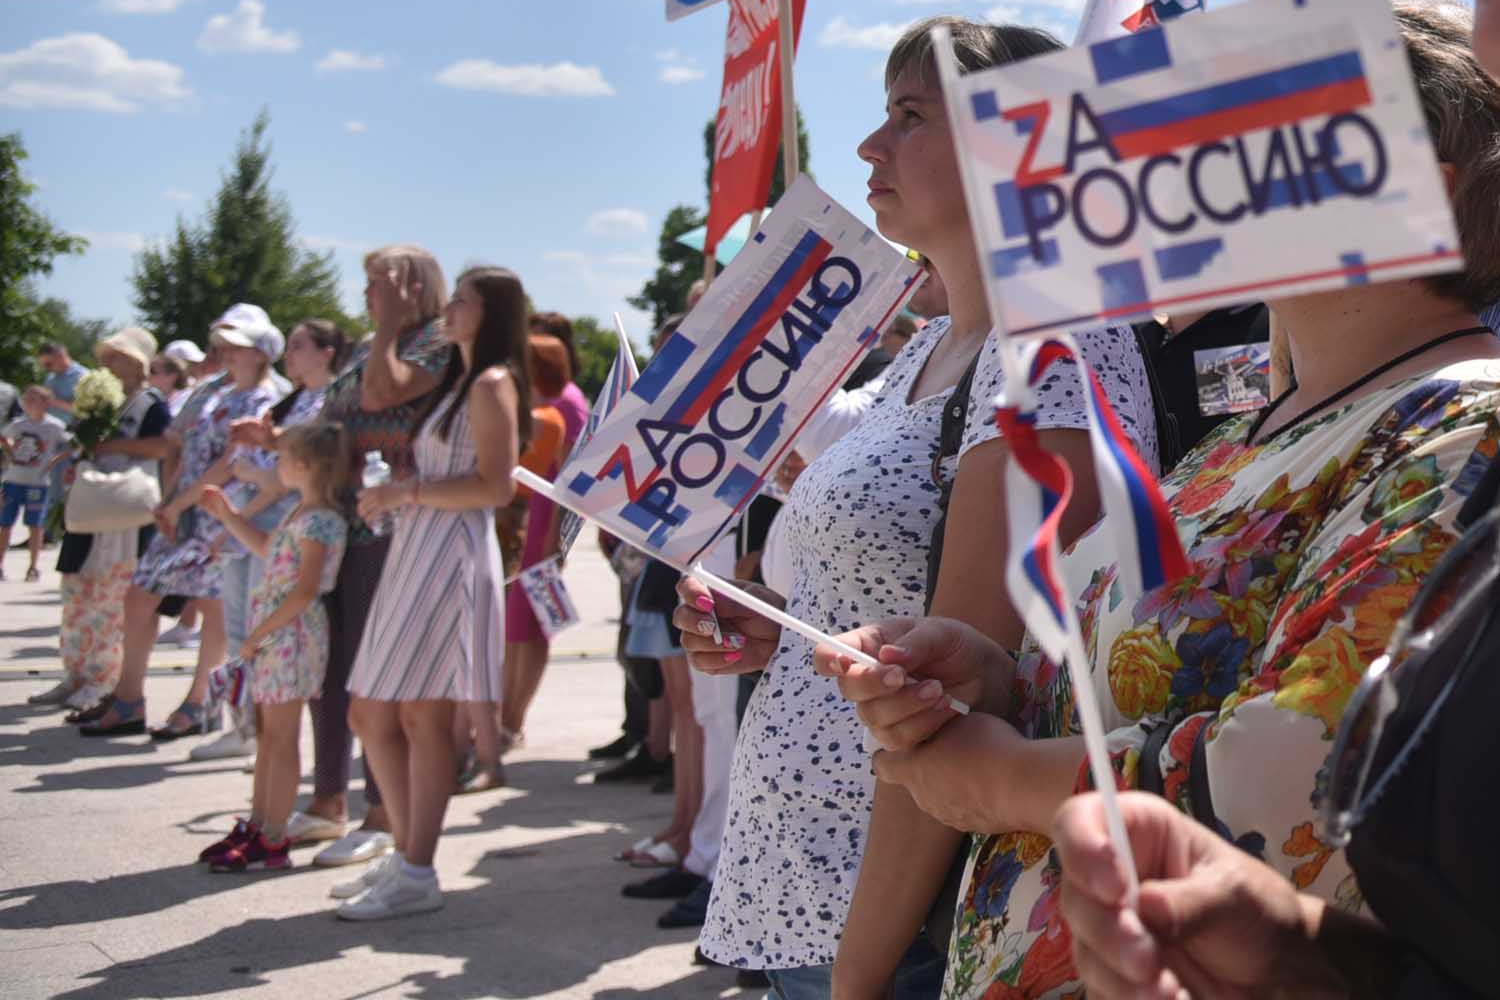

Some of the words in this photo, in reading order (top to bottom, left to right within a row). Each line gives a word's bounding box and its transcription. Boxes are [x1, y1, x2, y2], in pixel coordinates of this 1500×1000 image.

[1002, 91, 1120, 187] ZA
[1018, 111, 1389, 262] РОССИЮ
[631, 255, 862, 528] РОССИЮ
[594, 416, 693, 504] ZA
